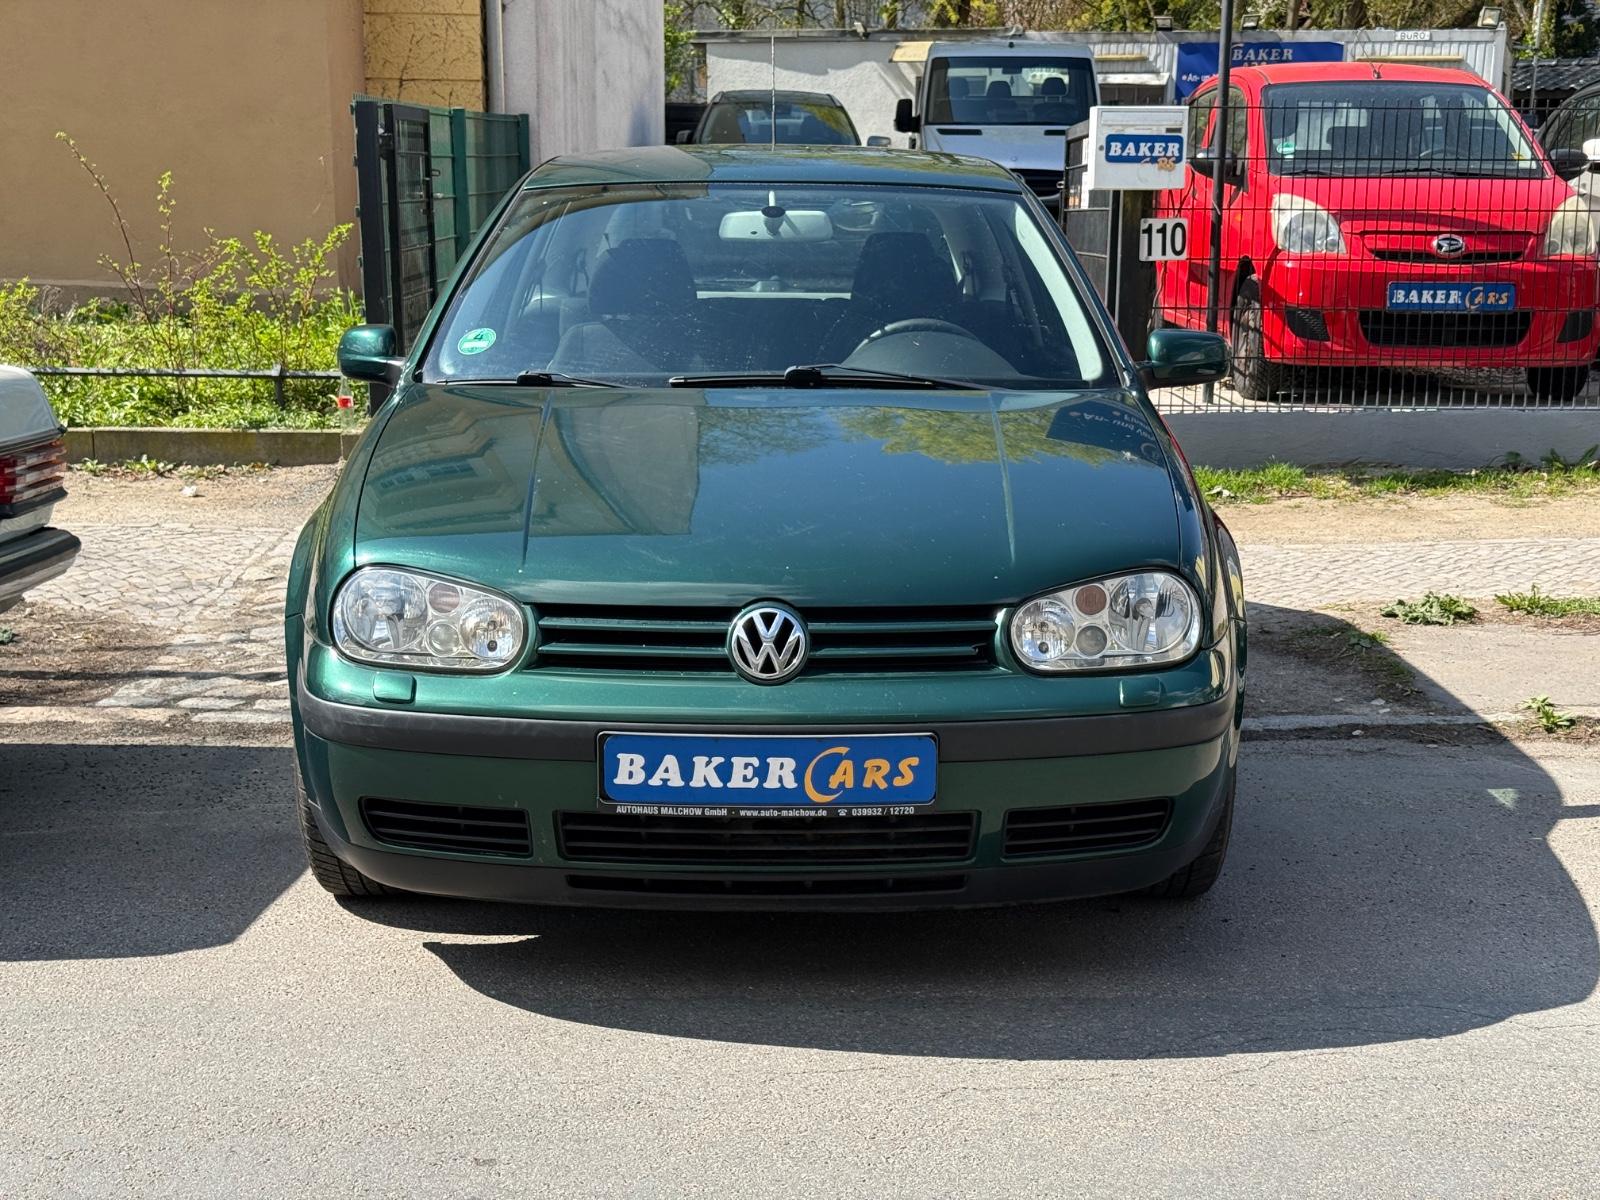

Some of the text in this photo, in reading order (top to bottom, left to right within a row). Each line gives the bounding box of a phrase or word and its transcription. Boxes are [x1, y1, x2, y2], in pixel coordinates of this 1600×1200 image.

[1231, 47, 1294, 61] BAKER
[1108, 141, 1180, 157] BAKER
[1141, 222, 1187, 257] 110
[1391, 286, 1509, 310] BAKER CARS
[613, 746, 920, 804] BAKER CARS
[616, 805, 659, 815] AUTOHAUS
[660, 806, 703, 816] MALCHOW
[704, 807, 728, 816] GmbH
[739, 808, 828, 817] www.auto-malchow.de
[851, 807, 882, 816] 039932
[889, 806, 915, 816] 12720
